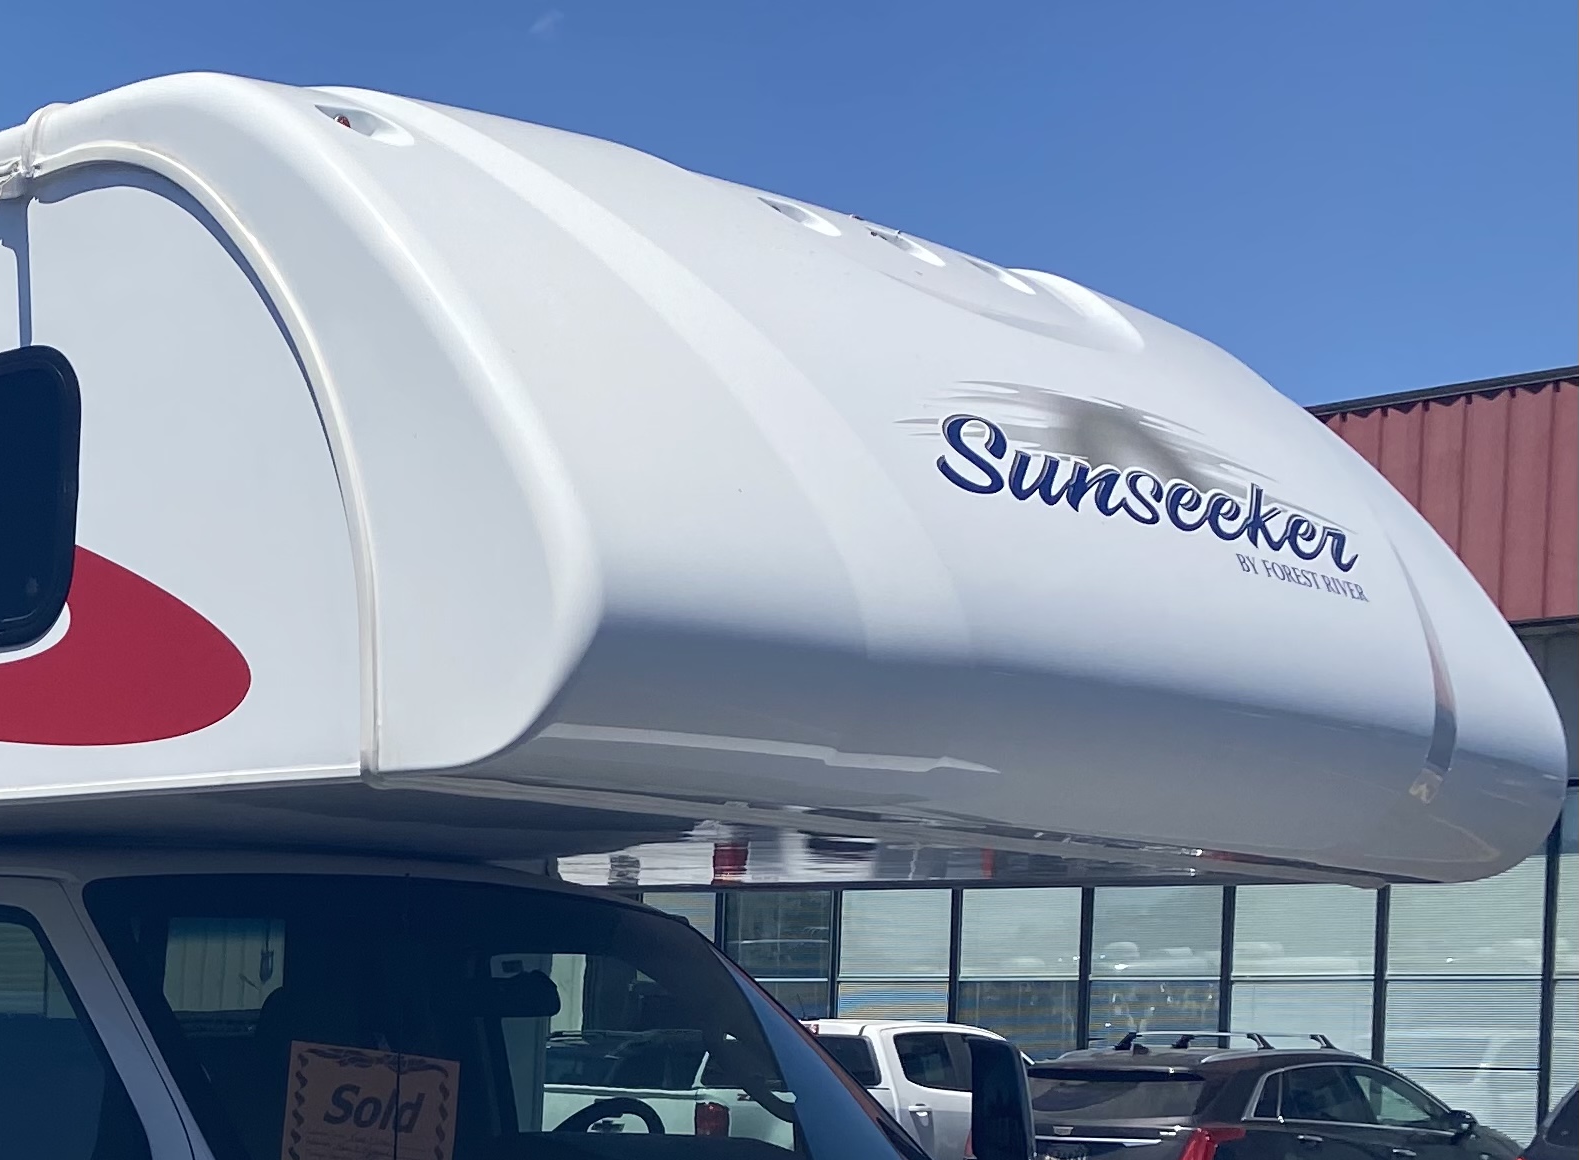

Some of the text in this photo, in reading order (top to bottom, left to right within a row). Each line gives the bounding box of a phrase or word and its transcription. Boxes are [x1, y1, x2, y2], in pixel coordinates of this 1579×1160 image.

[936, 414, 1358, 572] Sunseeker
[1235, 553, 1370, 602] BY FOREST RIVER
[323, 1083, 426, 1134] Sold
